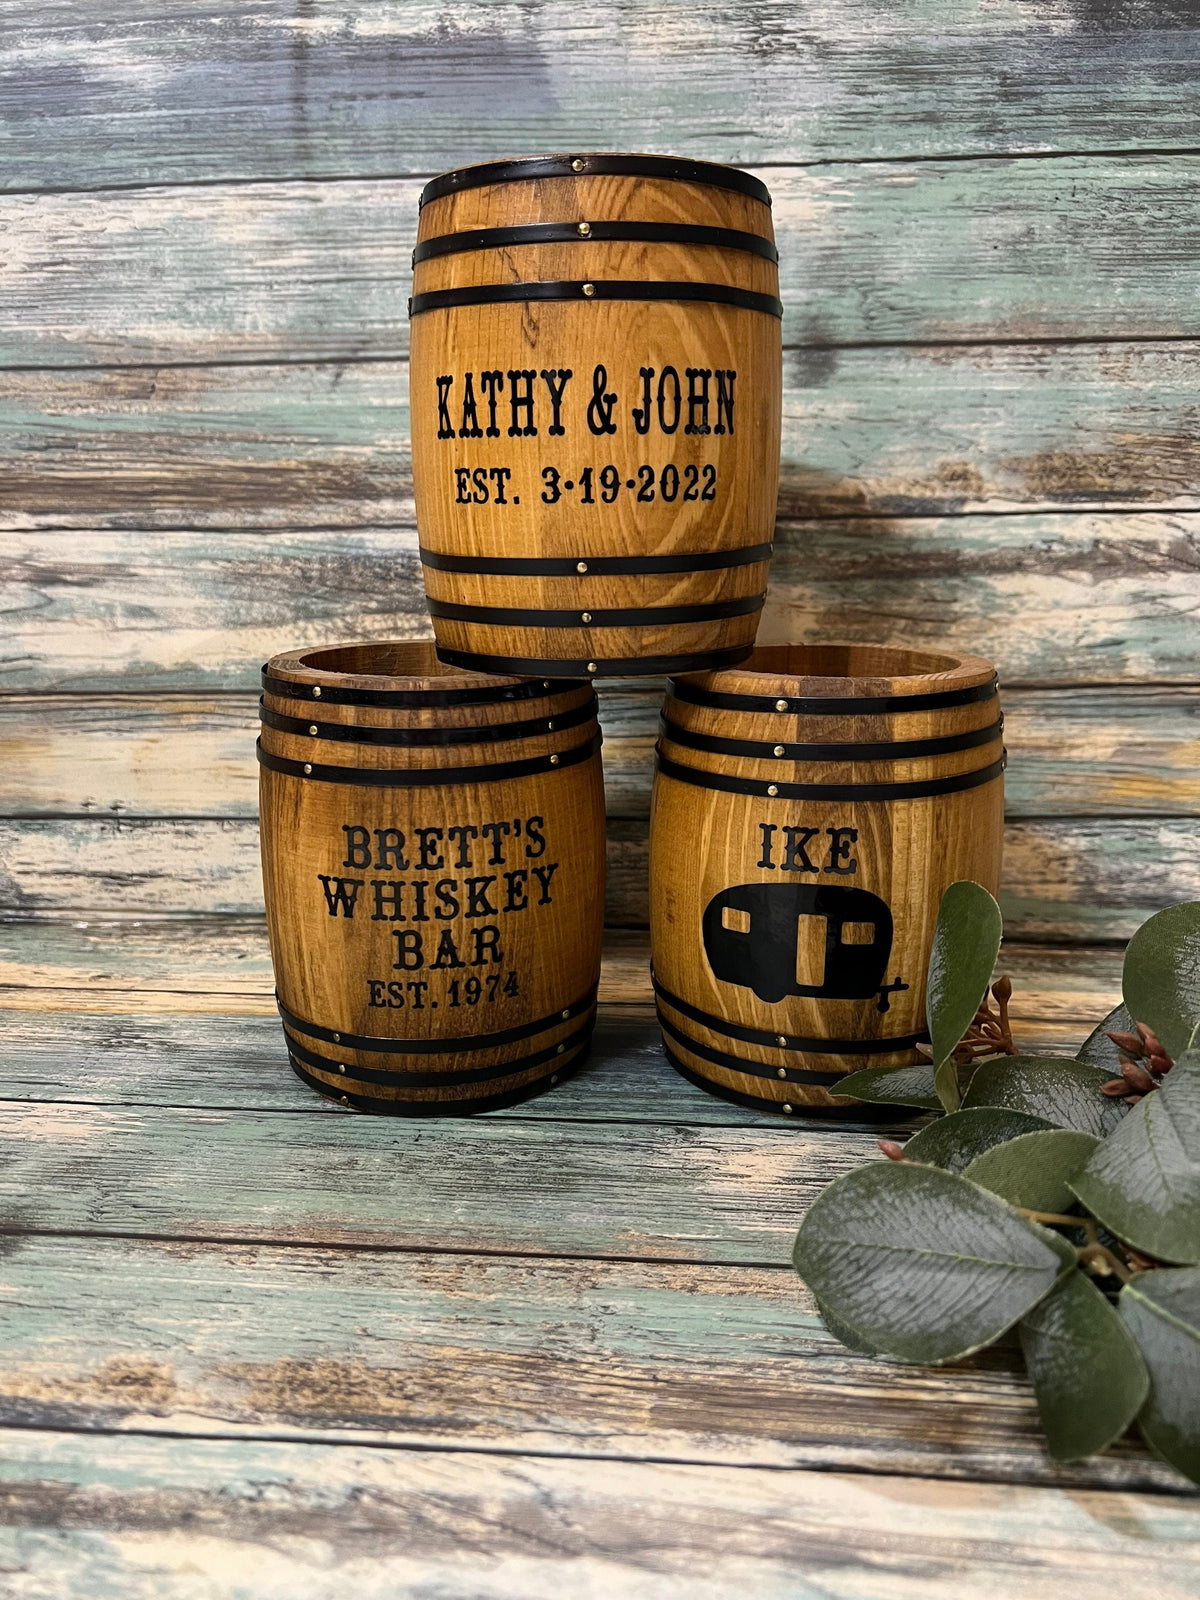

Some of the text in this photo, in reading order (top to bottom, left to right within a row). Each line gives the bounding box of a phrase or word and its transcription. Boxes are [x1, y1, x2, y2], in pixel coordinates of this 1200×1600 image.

[436, 364, 737, 439] KATHY & JOHN
[455, 467, 520, 504] EST.
[342, 816, 546, 871] BRETT'S
[757, 823, 858, 875] IKE
[317, 863, 559, 922] WHISKEY
[392, 925, 504, 971] BAR
